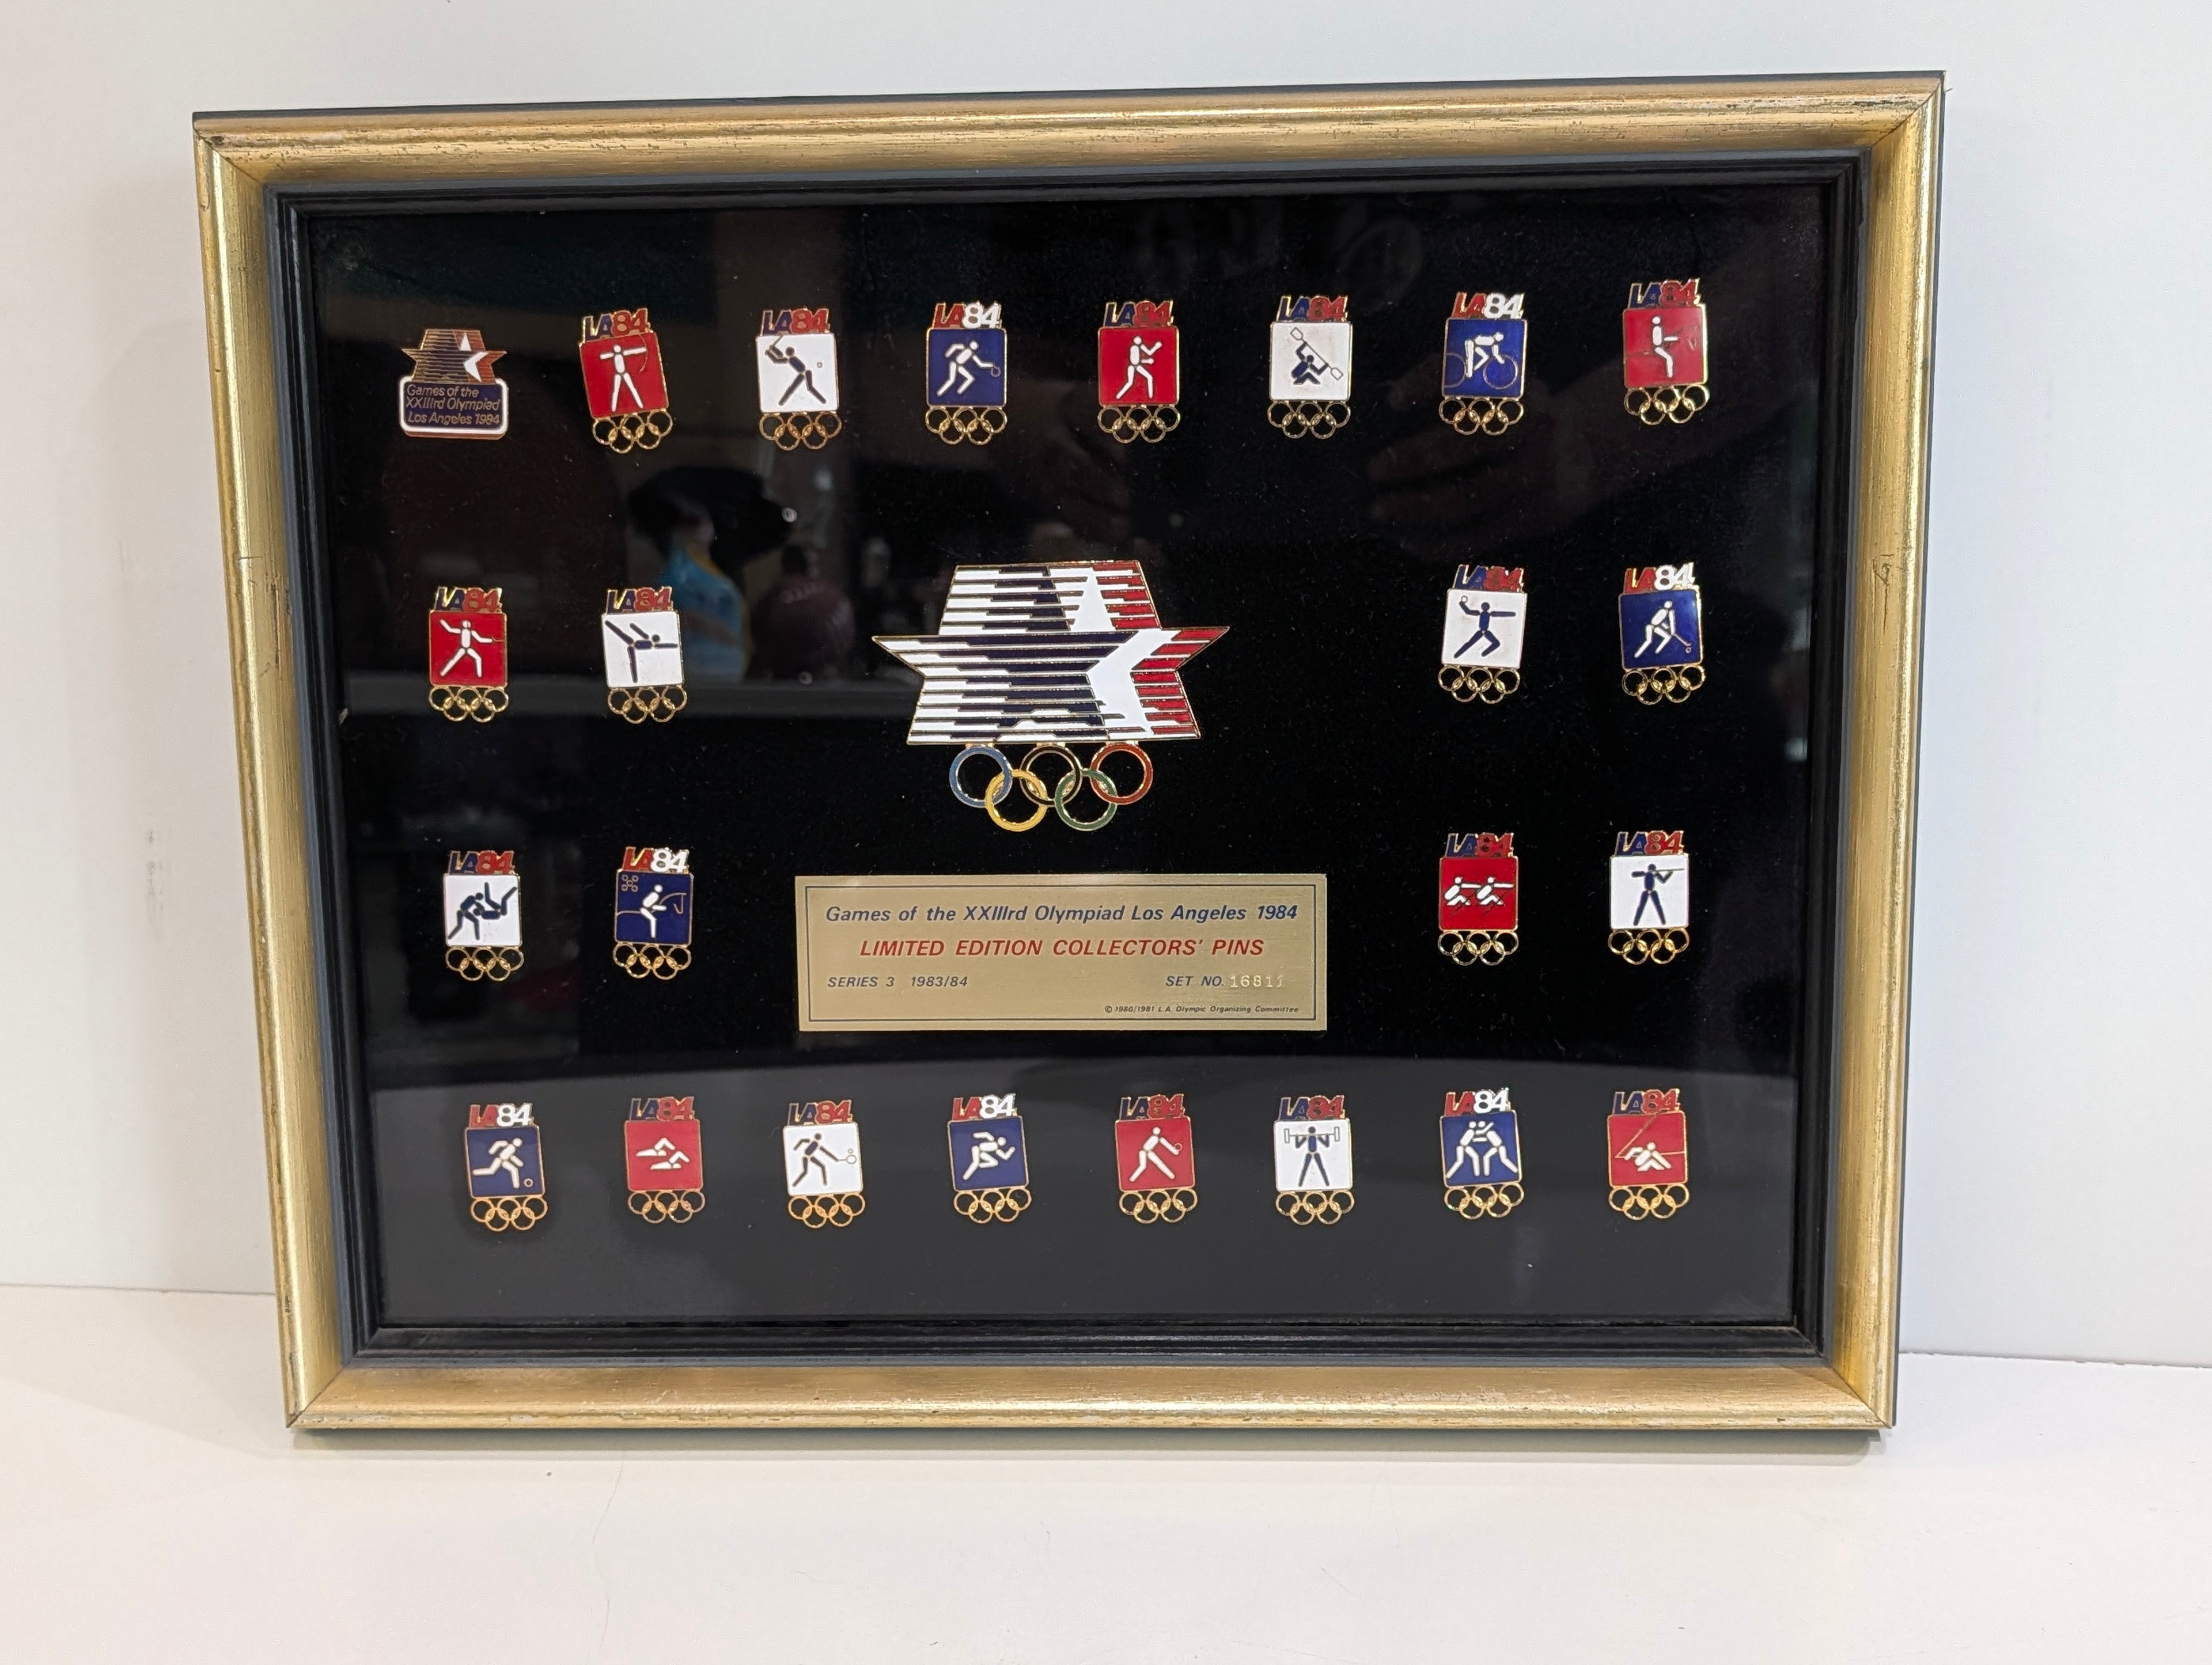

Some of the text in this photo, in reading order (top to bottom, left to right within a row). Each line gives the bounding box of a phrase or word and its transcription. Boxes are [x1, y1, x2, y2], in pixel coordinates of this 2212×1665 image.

[1452, 292, 1524, 318] LA84
[1628, 278, 1700, 308] LA84
[933, 302, 1002, 329] LA84
[1103, 300, 1174, 327] LA84
[1276, 295, 1349, 321] LA84
[583, 308, 651, 340] LA84
[760, 308, 830, 335] LA84
[407, 384, 479, 397] Games of the
[406, 397, 501, 411] XXIIIrd Olympiad
[408, 412, 499, 425] Los Angeles 1984
[1453, 564, 1524, 591] LA84
[1623, 562, 1696, 593] LA84
[434, 586, 503, 612] LA84
[607, 586, 673, 613] LA84
[1445, 832, 1514, 857] LA84
[1614, 830, 1684, 855] LA84
[448, 850, 514, 875] LA84
[623, 847, 690, 873] LA84
[826, 905, 1298, 924] Games of the XXIIIrd Olympiad Los Angeles 1984
[860, 940, 945, 956] LIMITED
[955, 939, 1043, 956] EDITION
[1211, 939, 1264, 955] PINS
[827, 976, 968, 988] SERIES 3 1983/84
[1165, 976, 1193, 987] SET
[1201, 976, 1224, 987] NO.
[628, 1096, 695, 1121] LA84
[788, 1099, 853, 1125] LA84
[952, 1093, 1017, 1120] LA84
[1119, 1094, 1185, 1120] LA84
[1278, 1094, 1345, 1120] LA84
[1444, 1088, 1510, 1116] LA84
[1612, 1088, 1680, 1114] LA84
[468, 1102, 535, 1128] LA84
